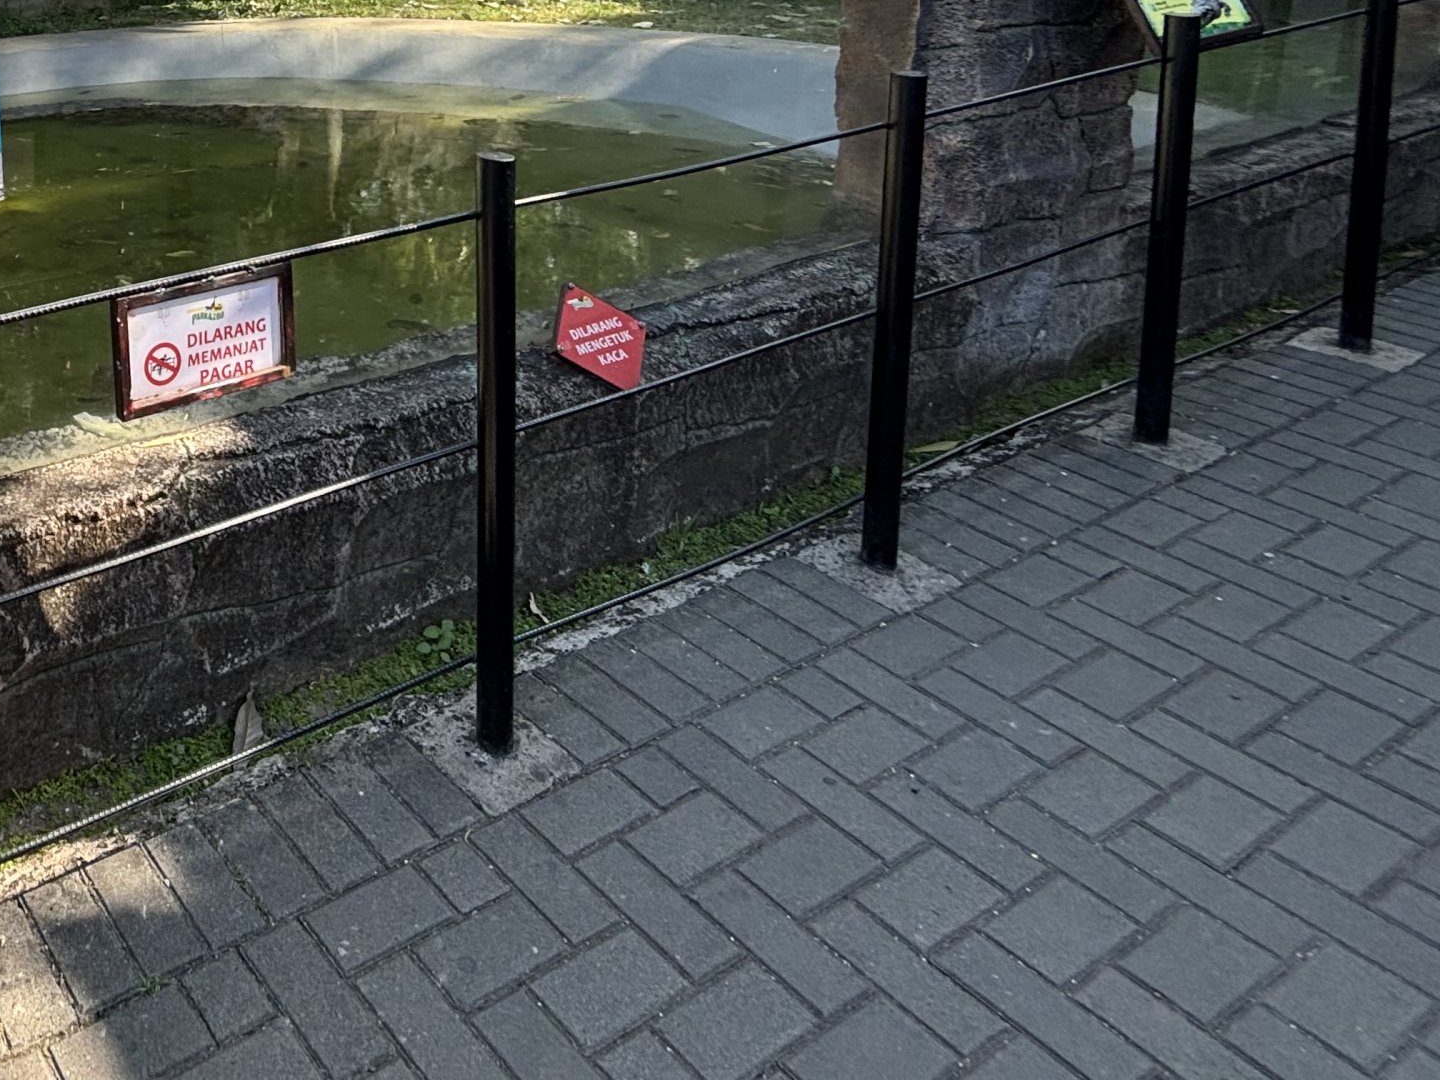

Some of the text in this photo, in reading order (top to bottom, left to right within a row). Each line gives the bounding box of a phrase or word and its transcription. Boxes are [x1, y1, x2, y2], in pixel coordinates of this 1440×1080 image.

[187, 318, 266, 348] DILARANG
[569, 316, 623, 340] DILARANG
[187, 338, 267, 367] MEMANJAT
[575, 330, 634, 356] MENGETUK
[597, 348, 629, 366] KACA
[200, 359, 255, 385] PAGAR
